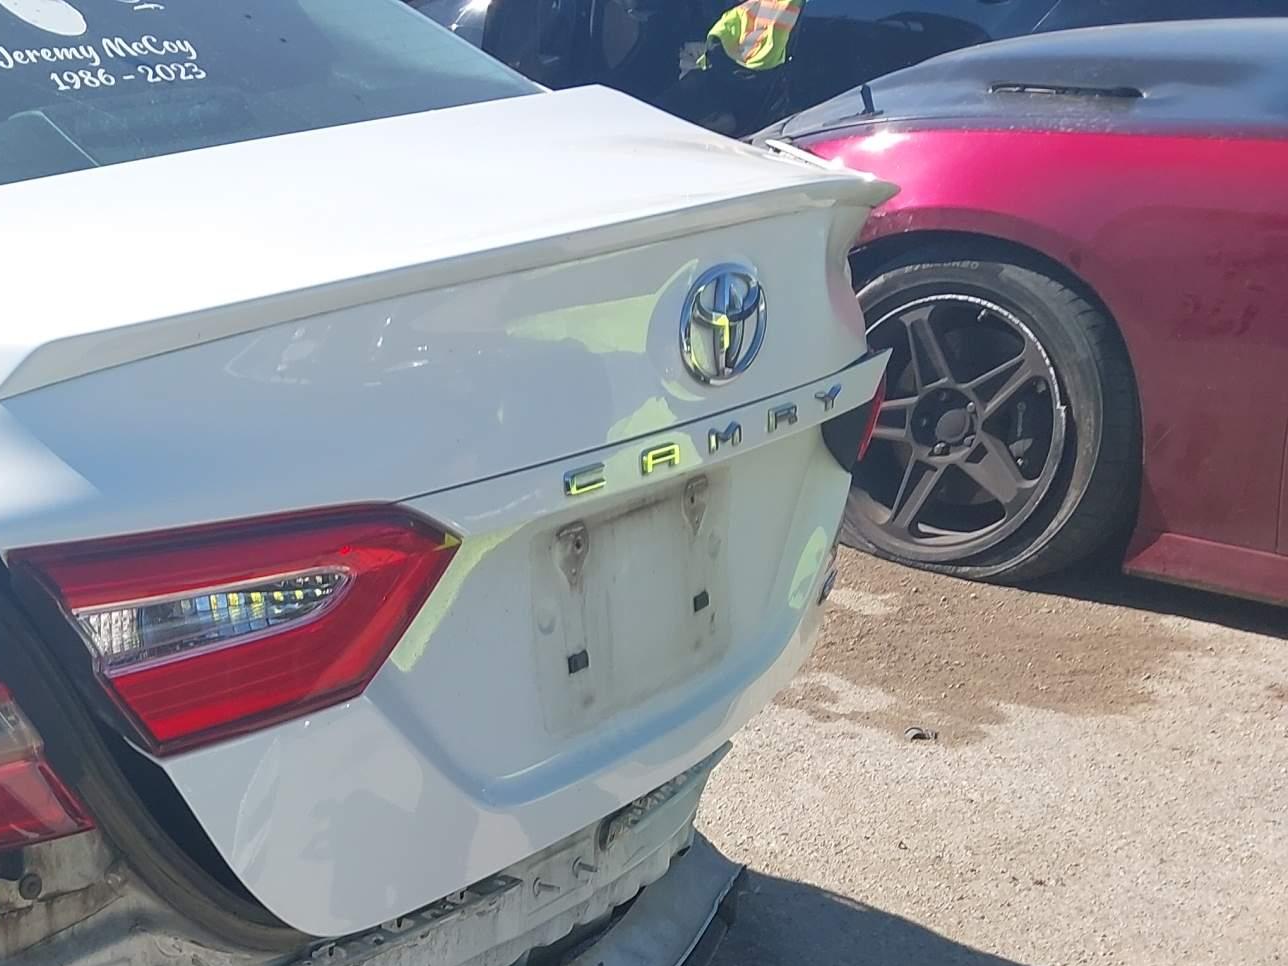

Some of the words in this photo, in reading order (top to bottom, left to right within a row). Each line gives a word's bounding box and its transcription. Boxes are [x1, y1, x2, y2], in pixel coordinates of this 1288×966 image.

[101, 35, 197, 60] McCoy
[50, 68, 116, 91] 1986
[137, 62, 207, 83] 2023
[564, 384, 842, 496] CAMRY
